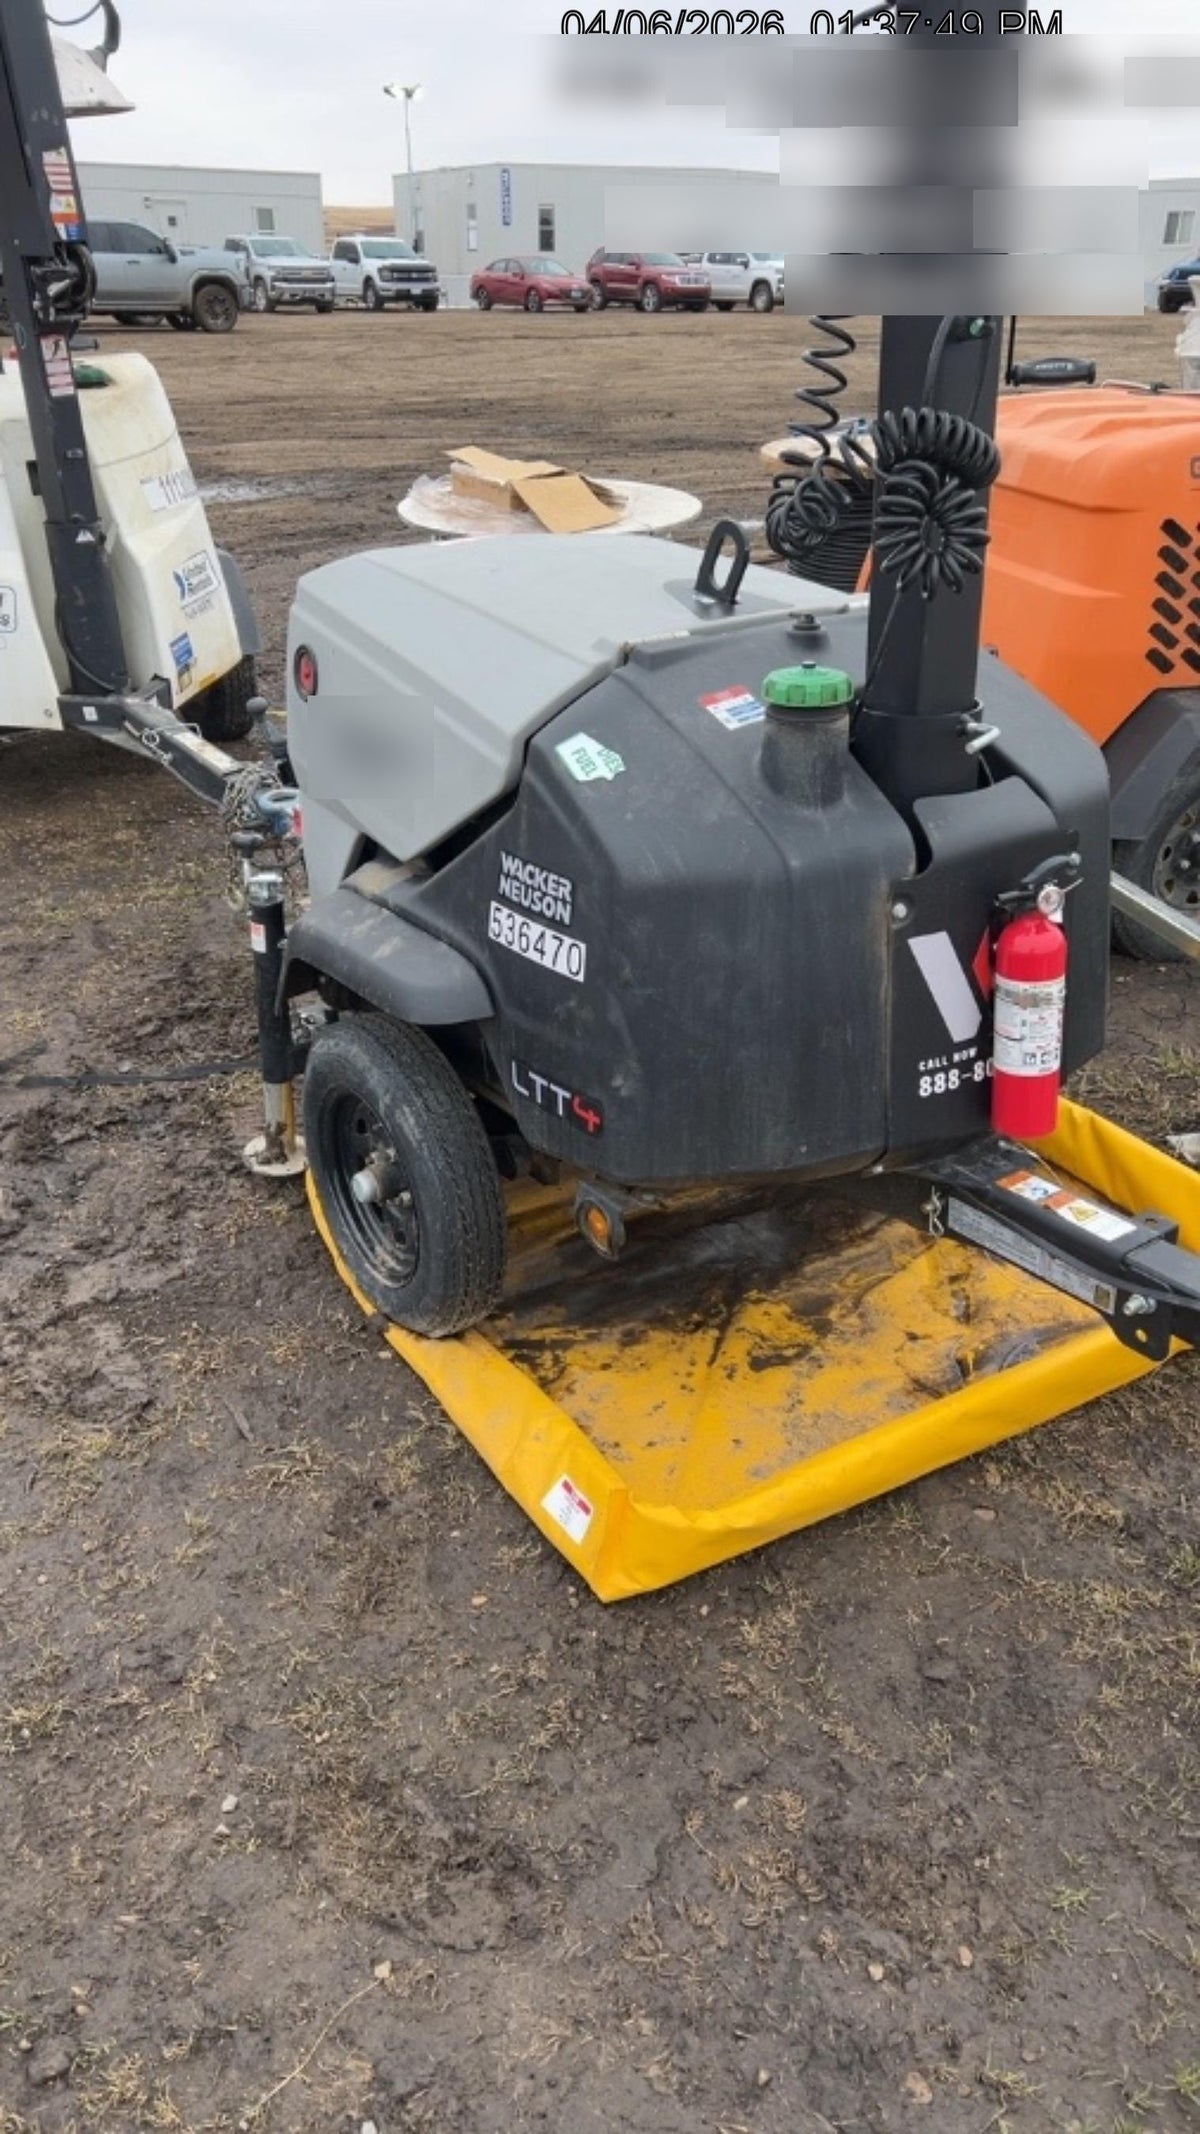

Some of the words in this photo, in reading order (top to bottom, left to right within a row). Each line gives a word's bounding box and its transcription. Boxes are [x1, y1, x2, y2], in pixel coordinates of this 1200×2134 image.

[571, 747, 598, 776] FUEL
[498, 874, 572, 925] NEUSON
[500, 851, 572, 902] WACKER
[491, 907, 582, 977] 536470
[919, 1056, 948, 1071] CALL
[953, 1047, 978, 1063] NOW
[511, 1060, 602, 1133] LTT4
